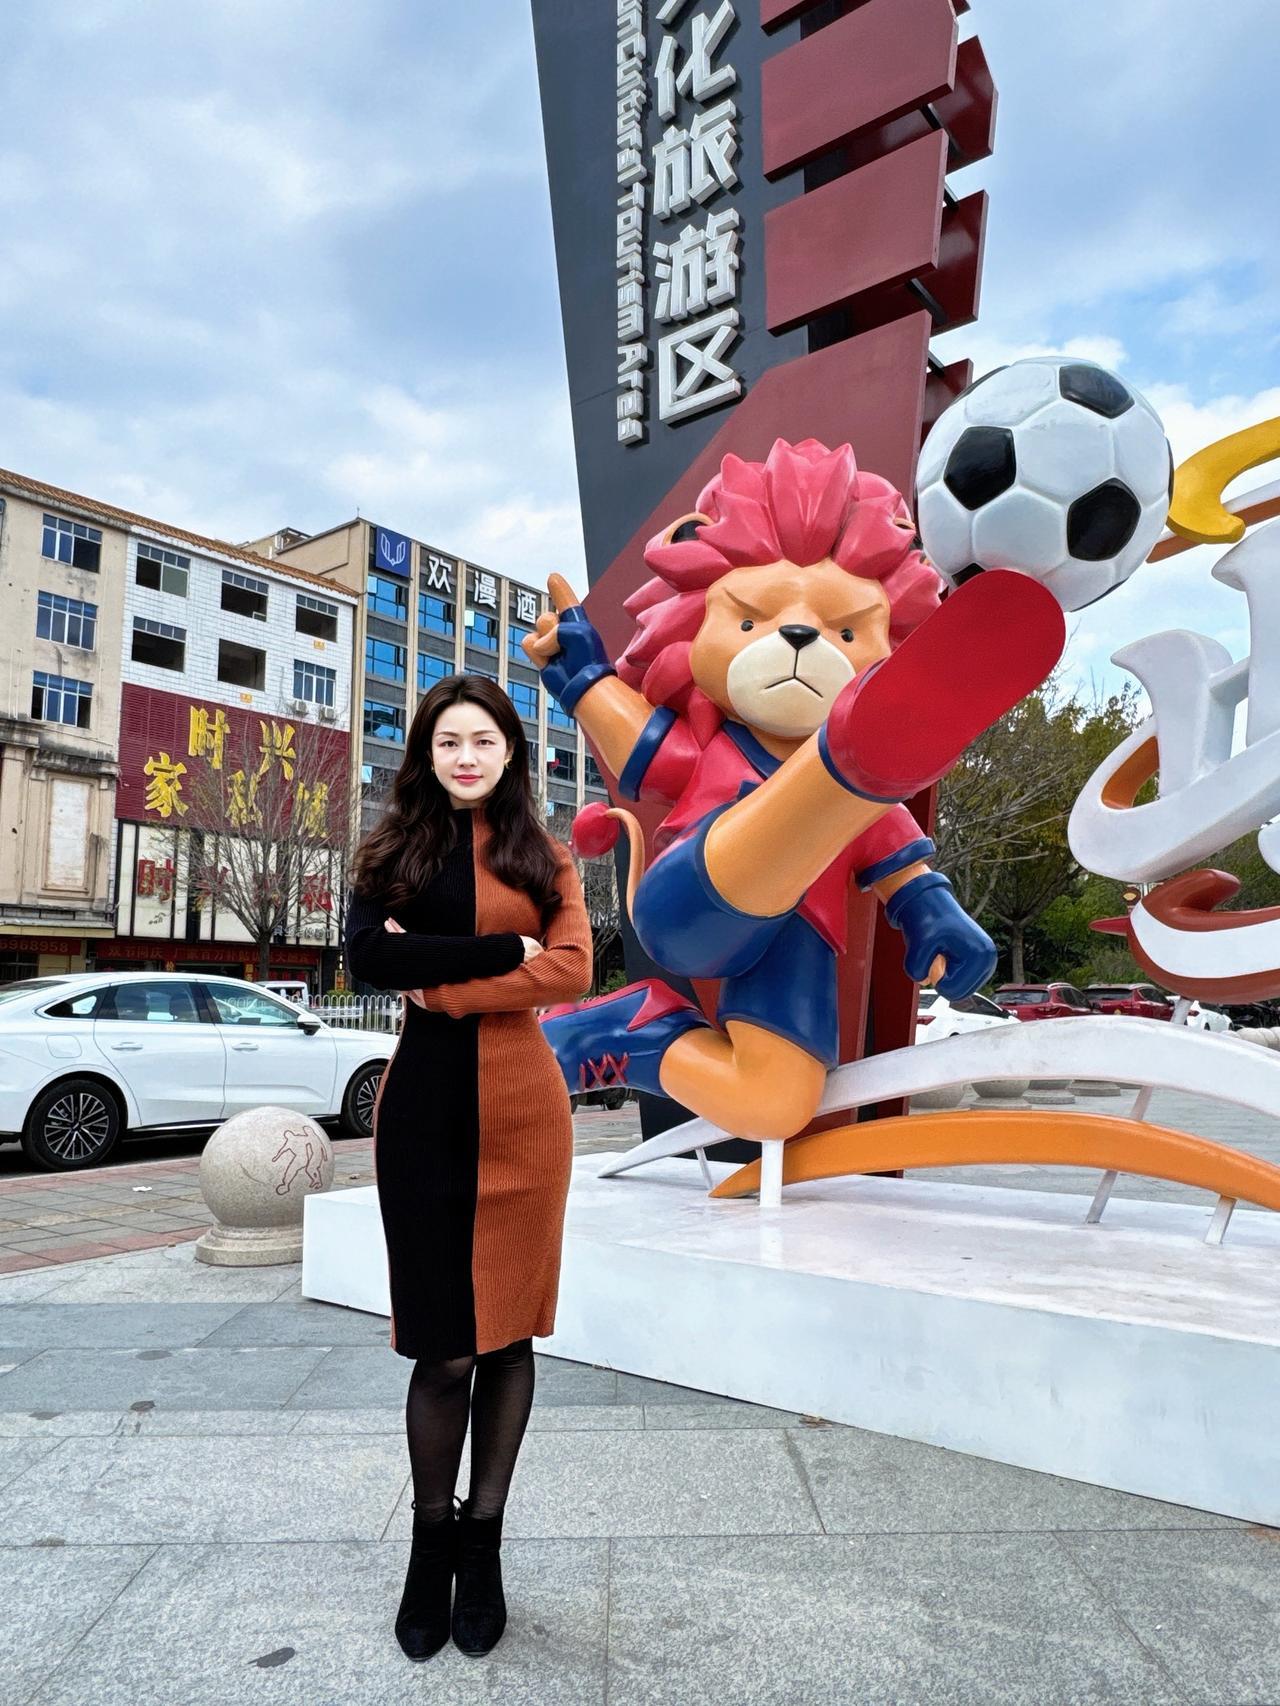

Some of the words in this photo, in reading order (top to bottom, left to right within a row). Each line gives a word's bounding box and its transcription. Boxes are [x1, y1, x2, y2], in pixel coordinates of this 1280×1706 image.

[616, 31, 647, 188] Cultural
[616, 181, 646, 342] Tourism
[653, 0, 742, 426] 化旅游区
[616, 342, 648, 446] Area
[425, 553, 538, 625] 欢漫酒
[187, 704, 297, 782] 时兴
